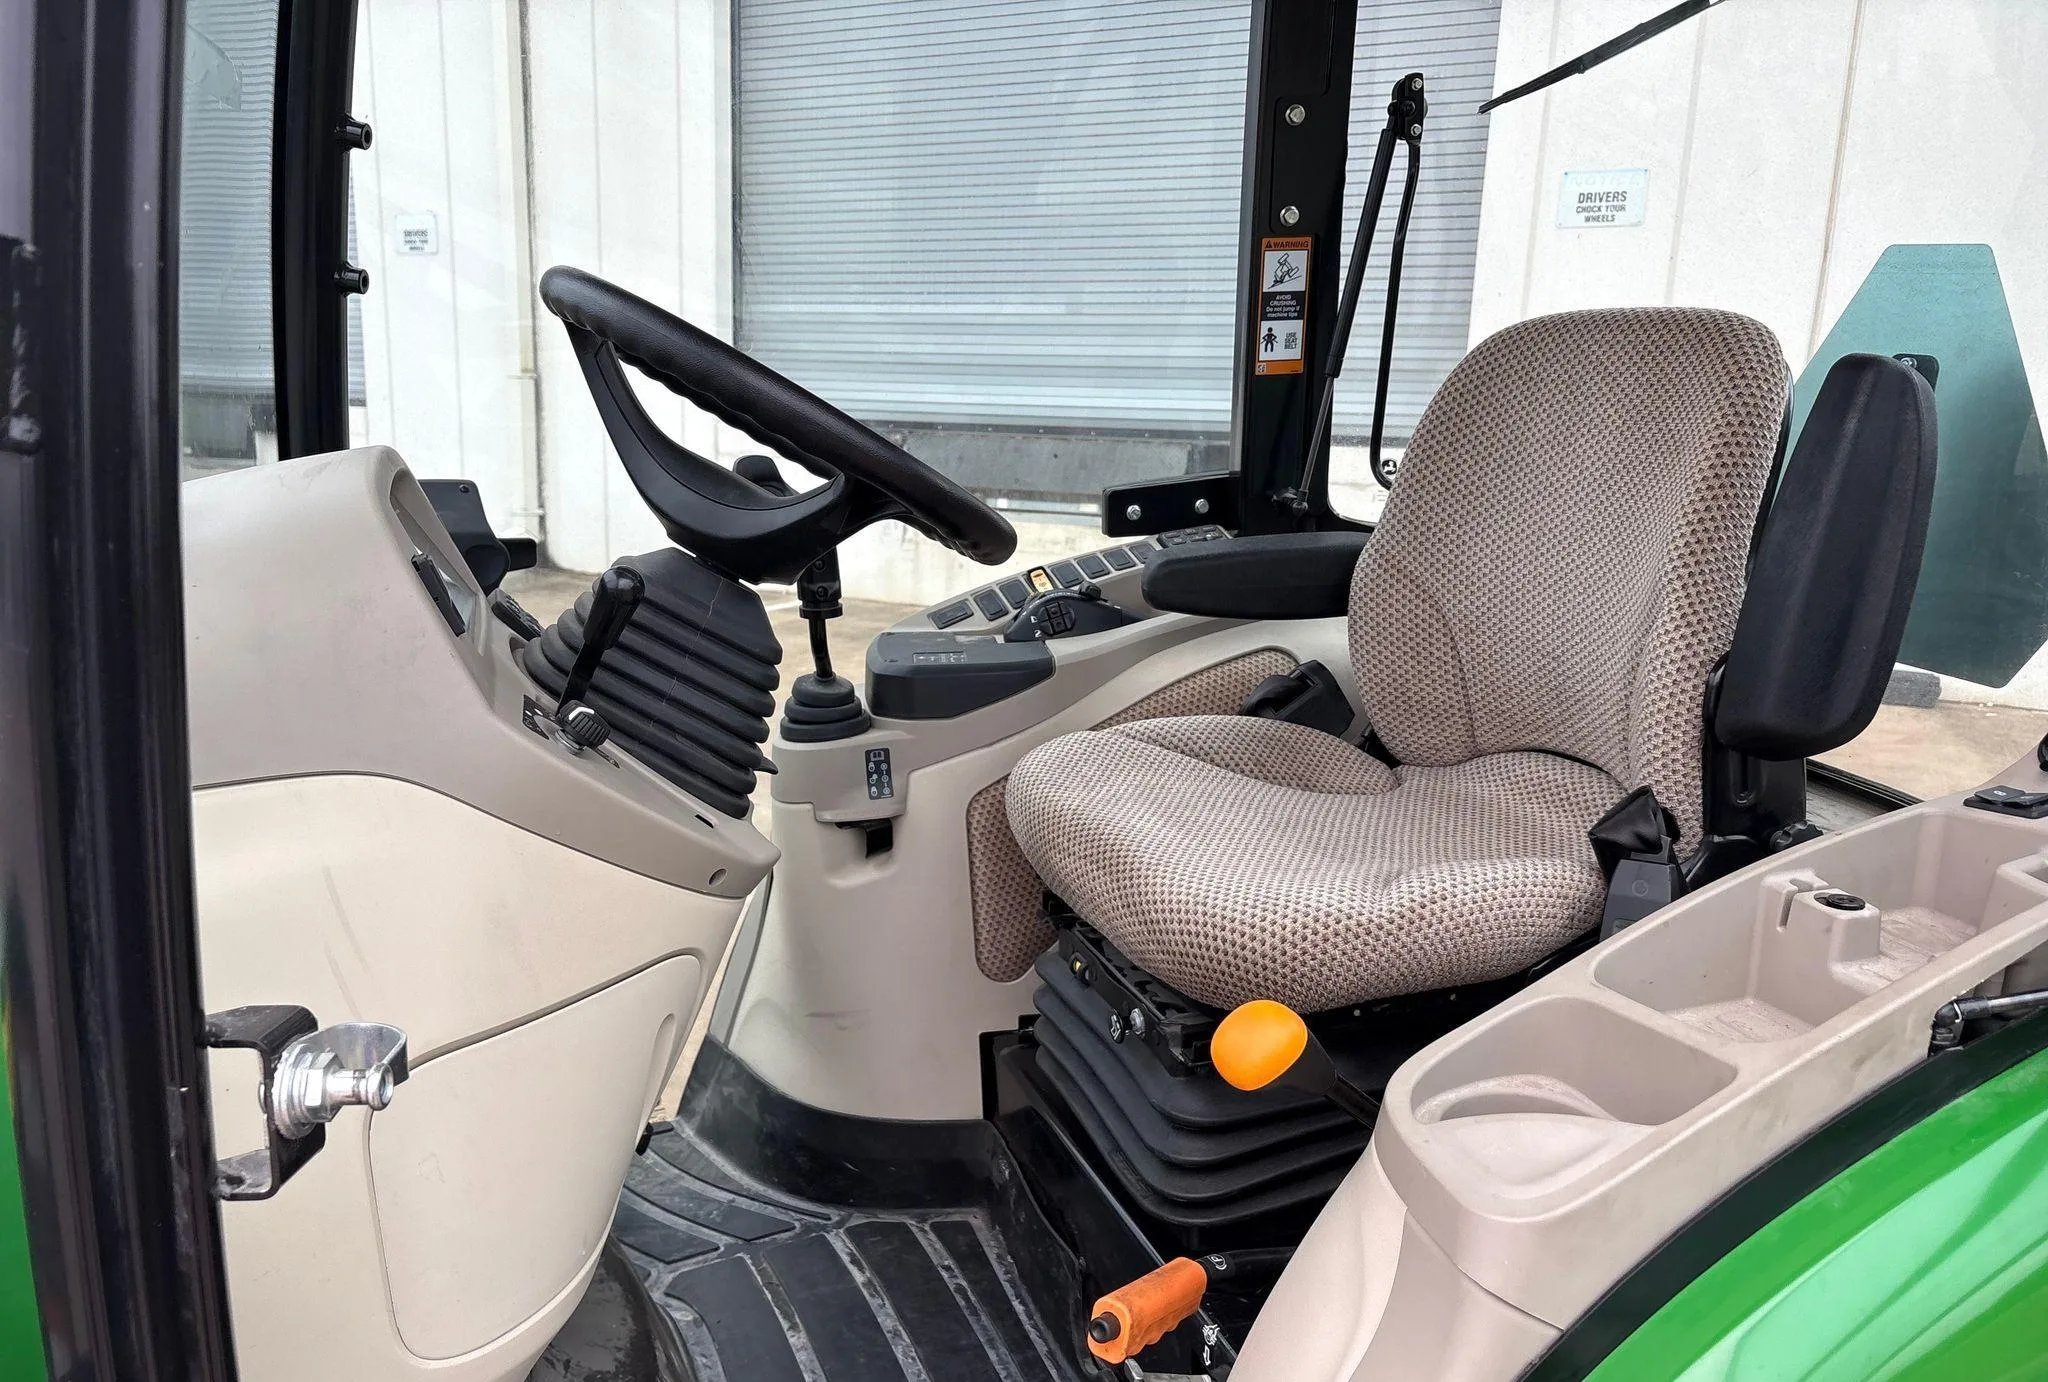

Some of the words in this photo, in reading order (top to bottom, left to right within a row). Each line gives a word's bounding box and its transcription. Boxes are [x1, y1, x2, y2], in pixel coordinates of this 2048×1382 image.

[1578, 191, 1628, 204] DRIVERS
[1576, 205, 1602, 214] CHOCK
[1605, 204, 1626, 213] YOUR
[1584, 214, 1616, 223] WHEELS
[1273, 240, 1309, 248] WARNING
